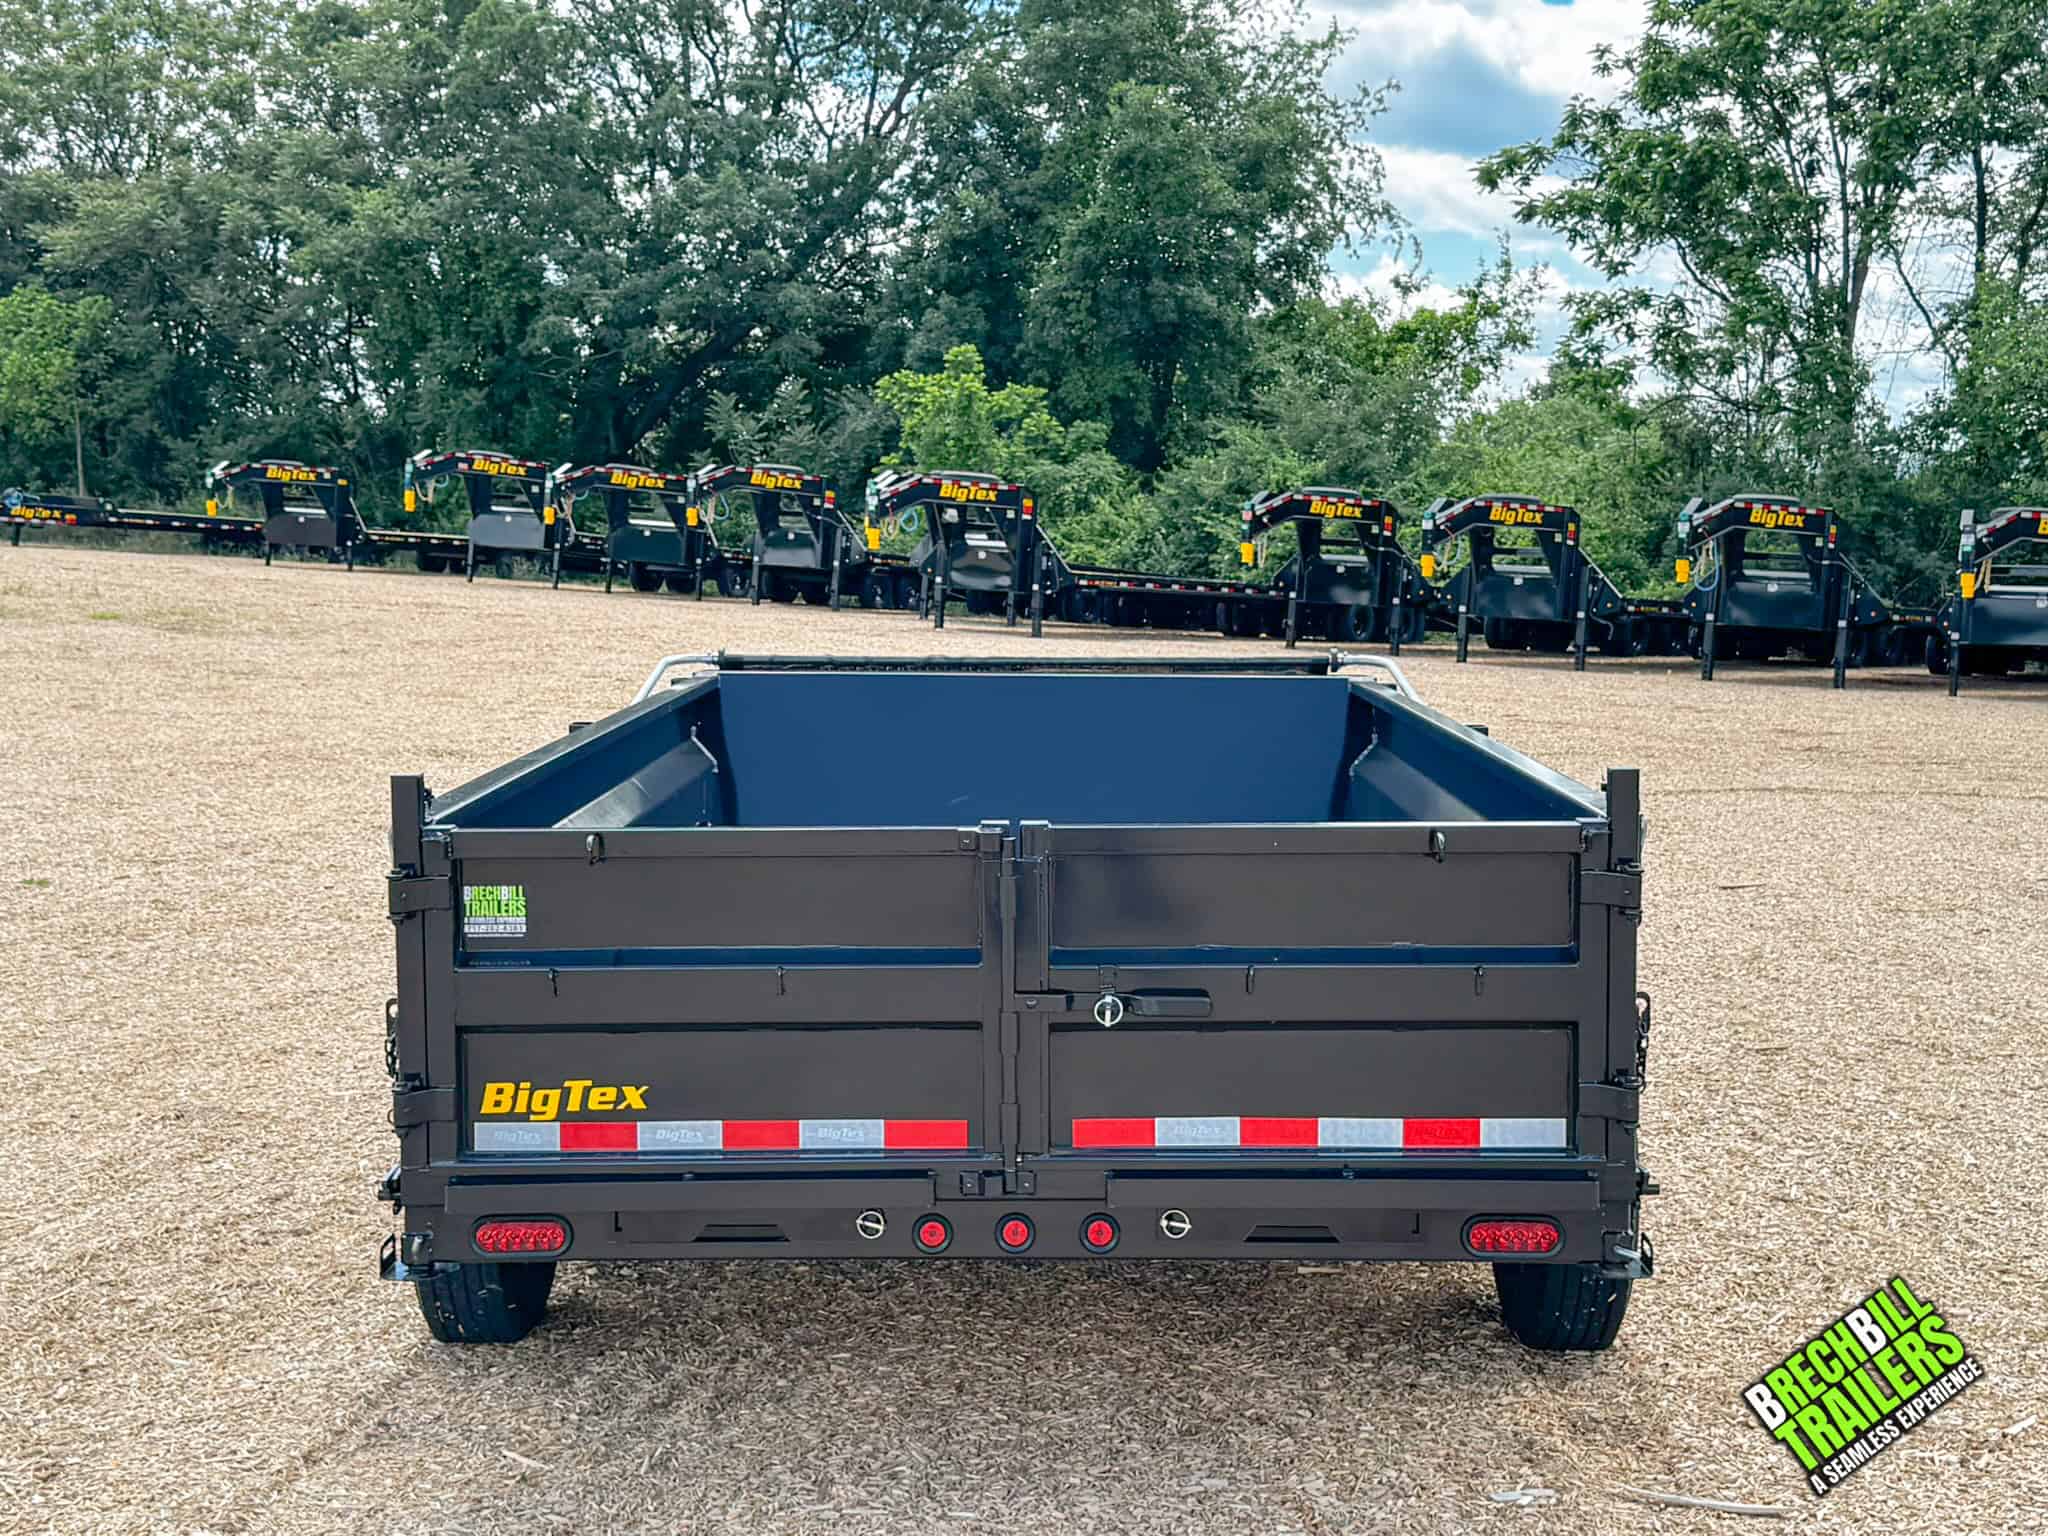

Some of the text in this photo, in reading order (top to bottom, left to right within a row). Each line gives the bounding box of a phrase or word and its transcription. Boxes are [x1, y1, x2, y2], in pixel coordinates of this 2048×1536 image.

[266, 467, 317, 482] BigTex
[472, 458, 527, 476] BigTex
[610, 472, 665, 489] BigTex
[750, 471, 802, 489] BigTex
[940, 484, 998, 502] BigTex
[1309, 500, 1362, 518] BigTex
[1489, 505, 1544, 525] BigTex
[1750, 508, 1804, 528] BigTex
[463, 886, 526, 900] BRECHBILL
[464, 901, 526, 917] TRAILERS
[480, 1080, 649, 1121] BigTex
[655, 1128, 703, 1143] BigTex
